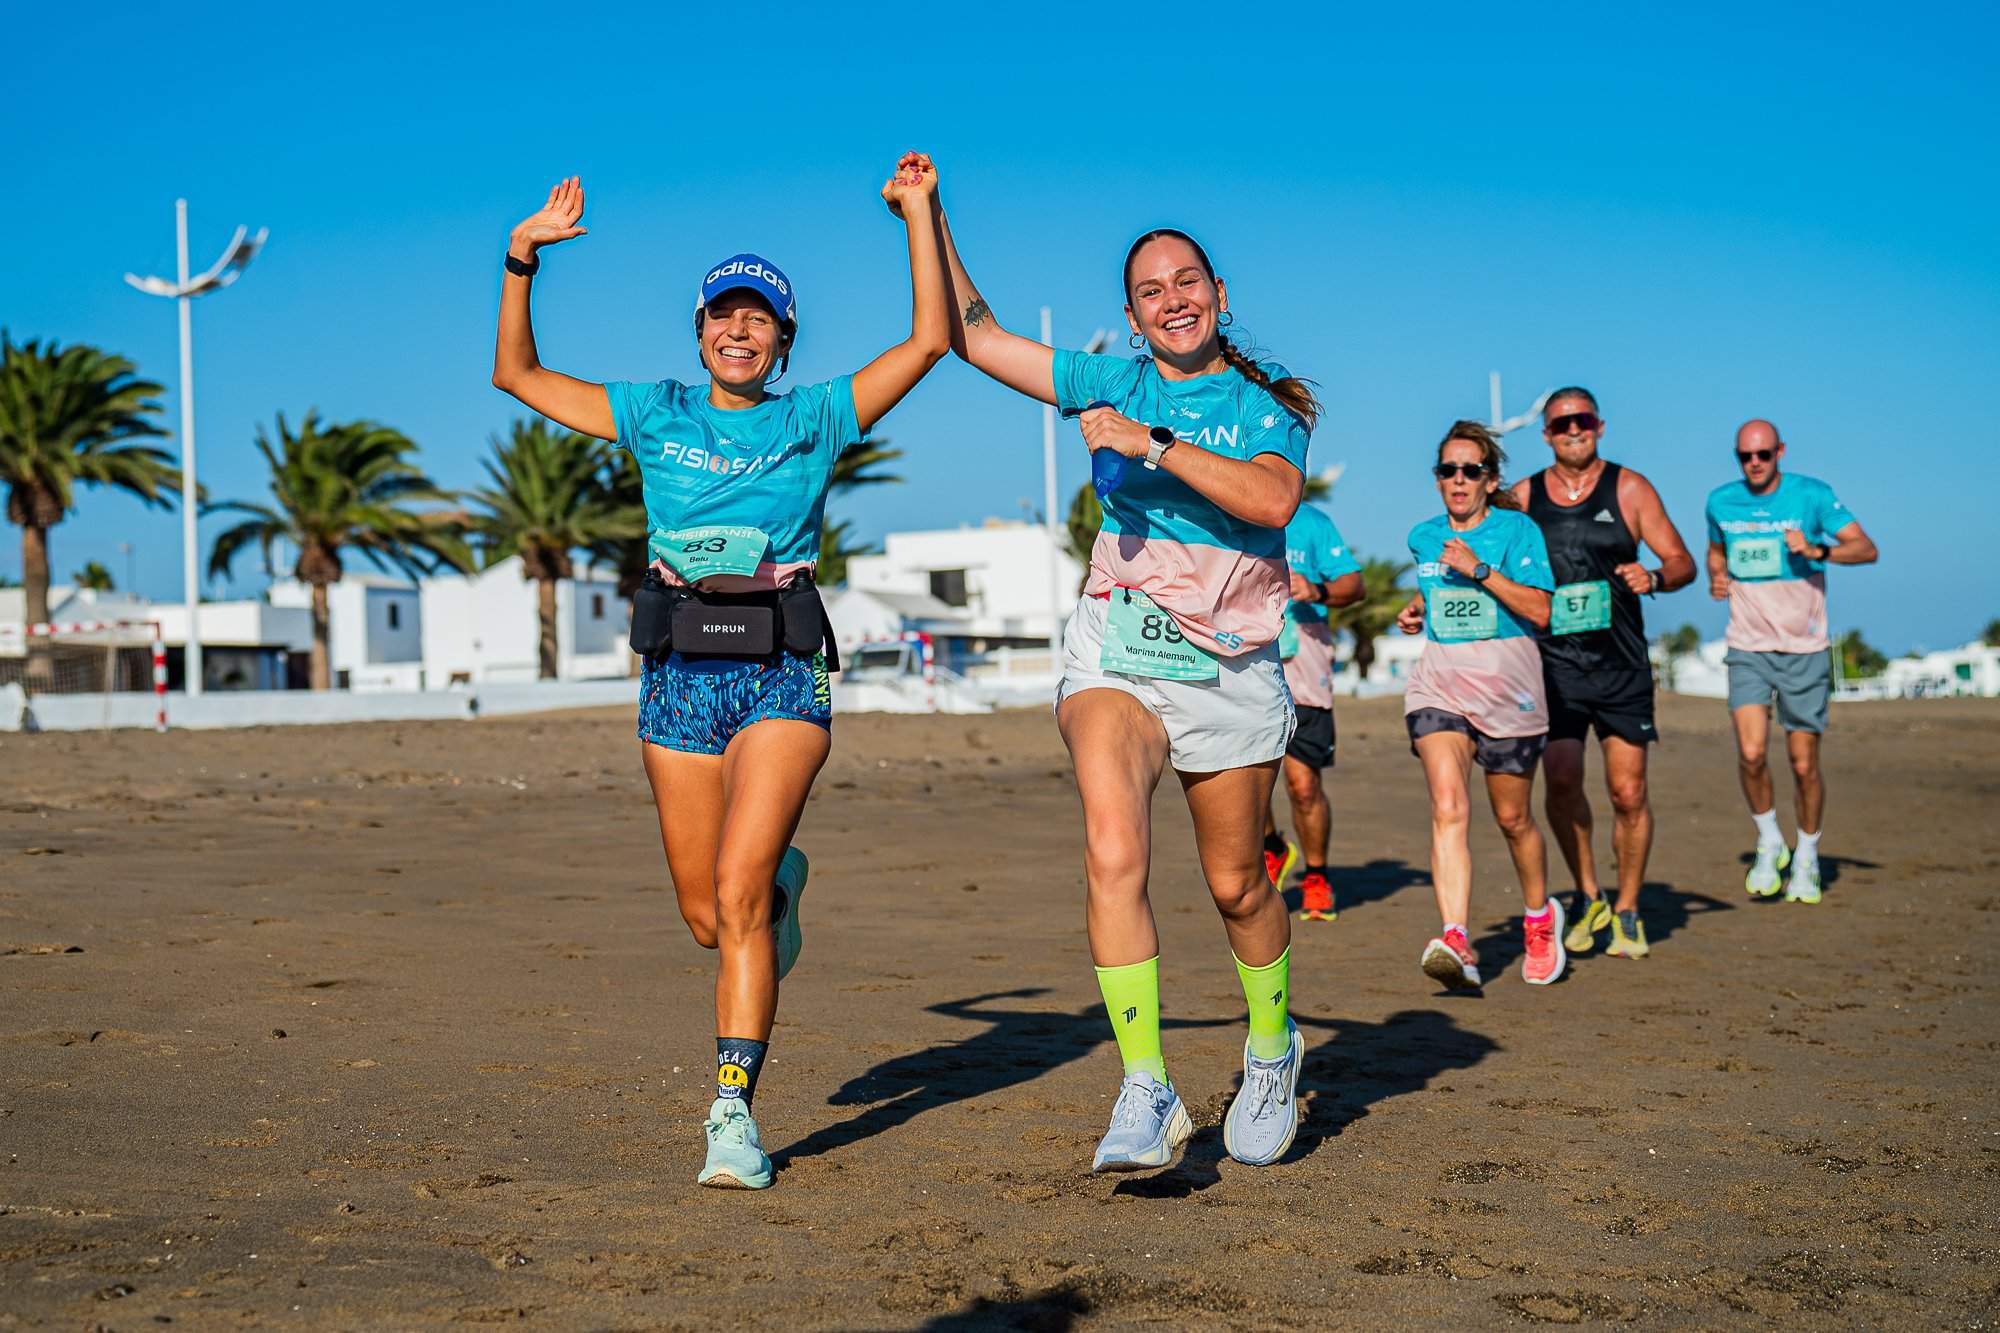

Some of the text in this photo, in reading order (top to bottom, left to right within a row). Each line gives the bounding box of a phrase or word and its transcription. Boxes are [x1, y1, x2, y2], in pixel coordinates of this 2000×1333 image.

[706, 261, 788, 295] adidas
[682, 537, 728, 553] 83
[1444, 601, 1481, 618] 222
[1566, 595, 1590, 612] 57
[702, 624, 746, 633] KIPRUN
[1141, 614, 1184, 644] 89
[1125, 645, 1196, 664] Marina Alemany
[719, 1051, 752, 1067] DEAD
